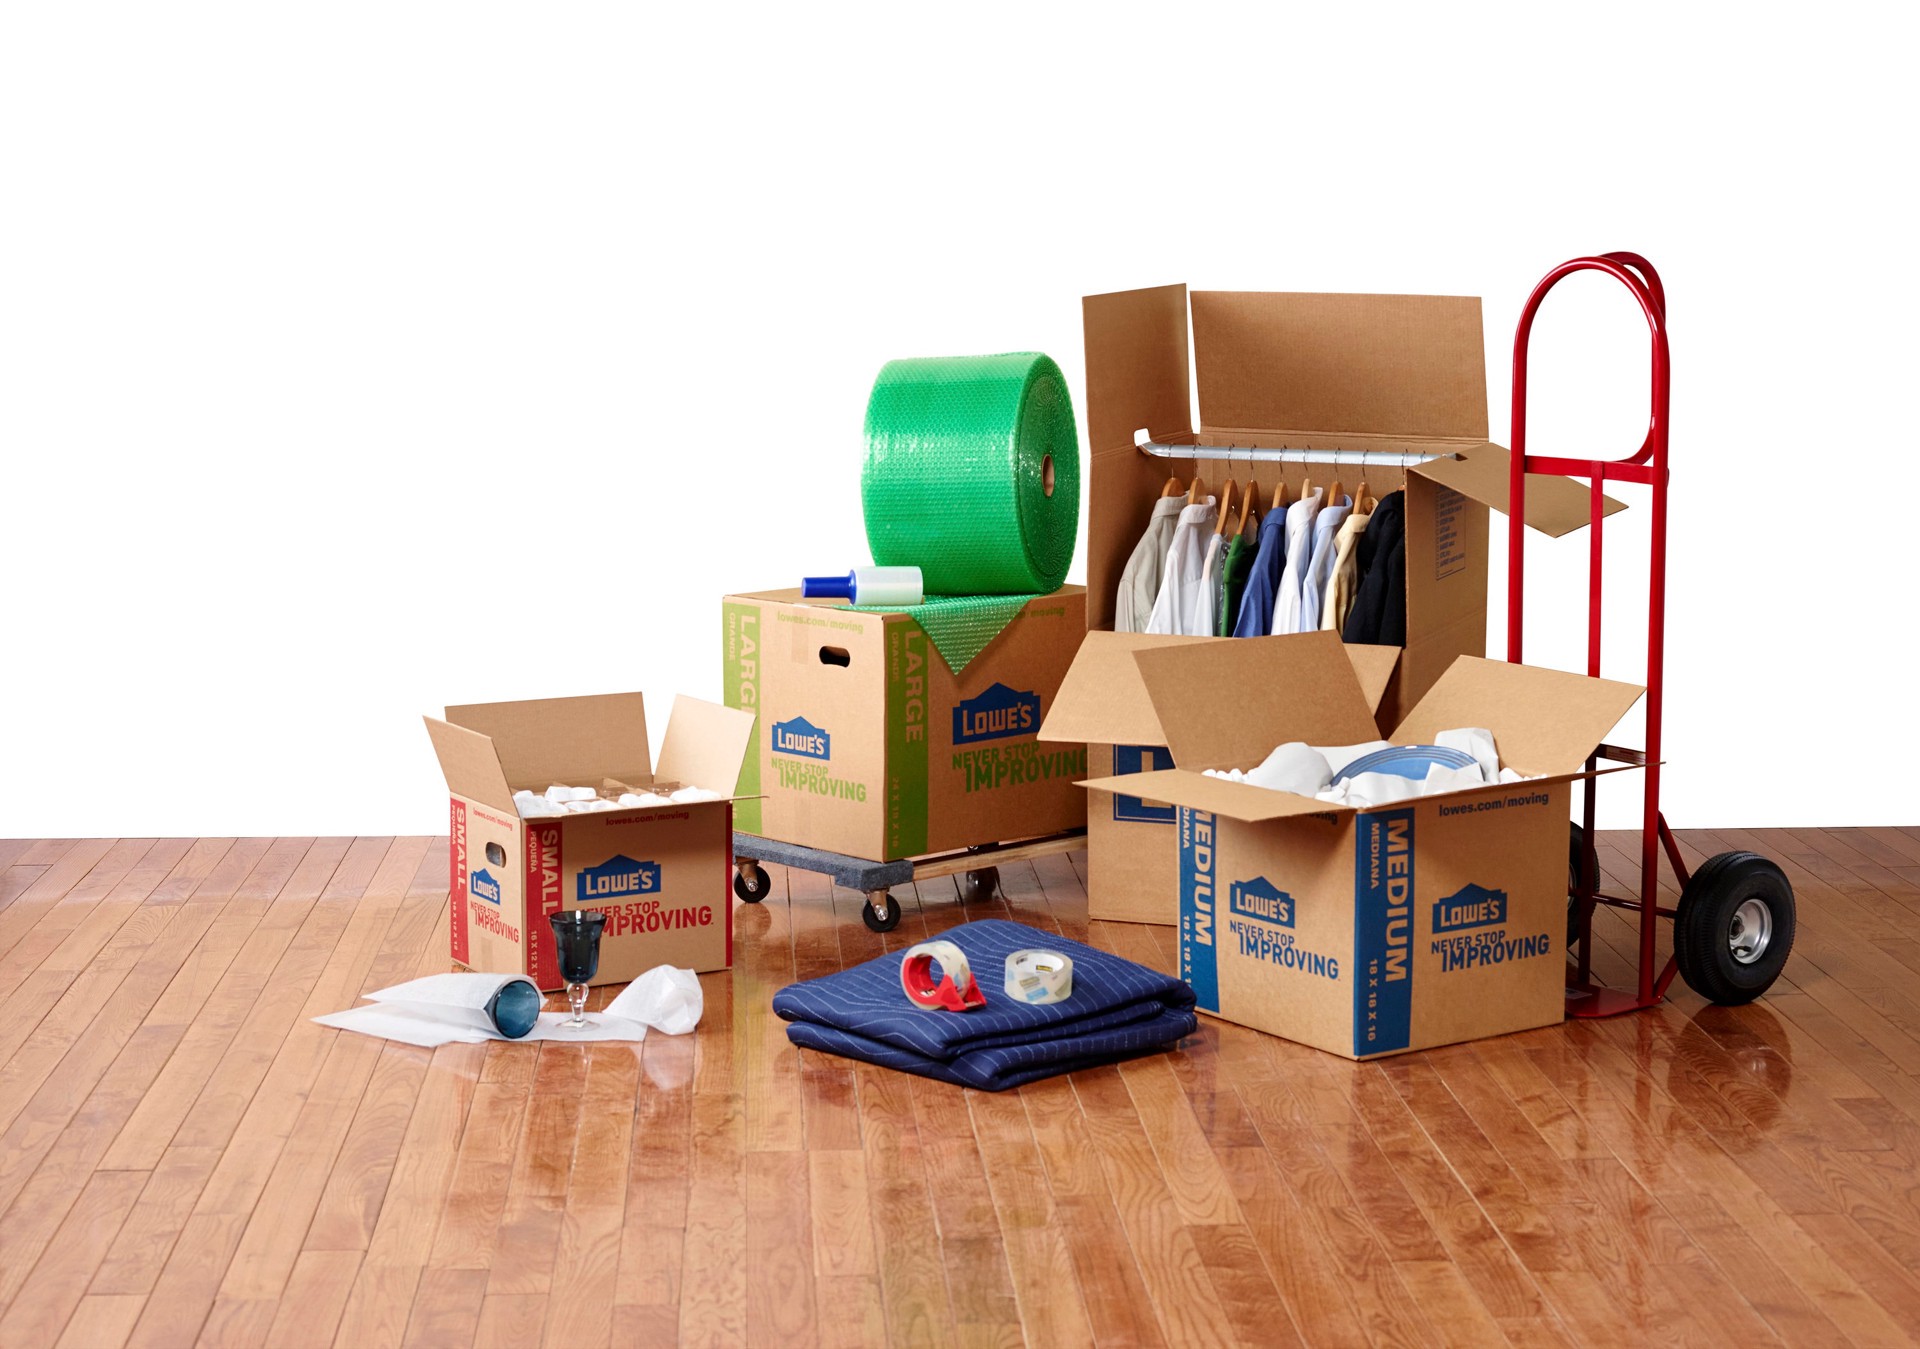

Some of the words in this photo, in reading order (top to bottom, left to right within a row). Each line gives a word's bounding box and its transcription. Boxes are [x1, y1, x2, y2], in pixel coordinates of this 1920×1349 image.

[777, 612, 864, 634] lowes.com/moving
[905, 631, 923, 743] LARGE
[963, 702, 1032, 736] LOWE'S
[778, 728, 825, 755] LOWE'S
[771, 757, 801, 772] NEVER
[804, 763, 828, 777] STOP
[952, 748, 999, 770] NEVER
[1004, 741, 1040, 760] STOP
[780, 767, 867, 802] IMPROVING
[1439, 792, 1549, 816] lowes.com/moving
[606, 811, 689, 826] lowes.com/moving
[456, 807, 466, 890] SMALL
[1371, 823, 1379, 889] MEDIANA
[542, 829, 558, 915] SMALL
[586, 869, 653, 895] LOWE'S
[473, 876, 498, 901] LOWE'S
[1385, 819, 1408, 982] MEDIUM
[471, 901, 486, 914] NEVER
[487, 908, 500, 919] STOP
[625, 901, 660, 915] STOP
[1236, 888, 1289, 922] LOWE'S
[1440, 898, 1500, 928] LOWE'S
[475, 909, 519, 943] IMPROVING
[601, 906, 712, 937] MPROVING
[1229, 920, 1264, 941] NEVER
[1267, 930, 1295, 947] STOP
[1431, 935, 1472, 955] NEVER
[1475, 930, 1506, 947] STOP
[1442, 933, 1549, 972] IMPROVING
[1240, 933, 1339, 980] IMPROVING
[1369, 958, 1378, 975] 18
[1185, 977, 1192, 988] 1
[1369, 978, 1378, 988] X
[1368, 992, 1377, 1008] 18
[1368, 1011, 1377, 1020] X
